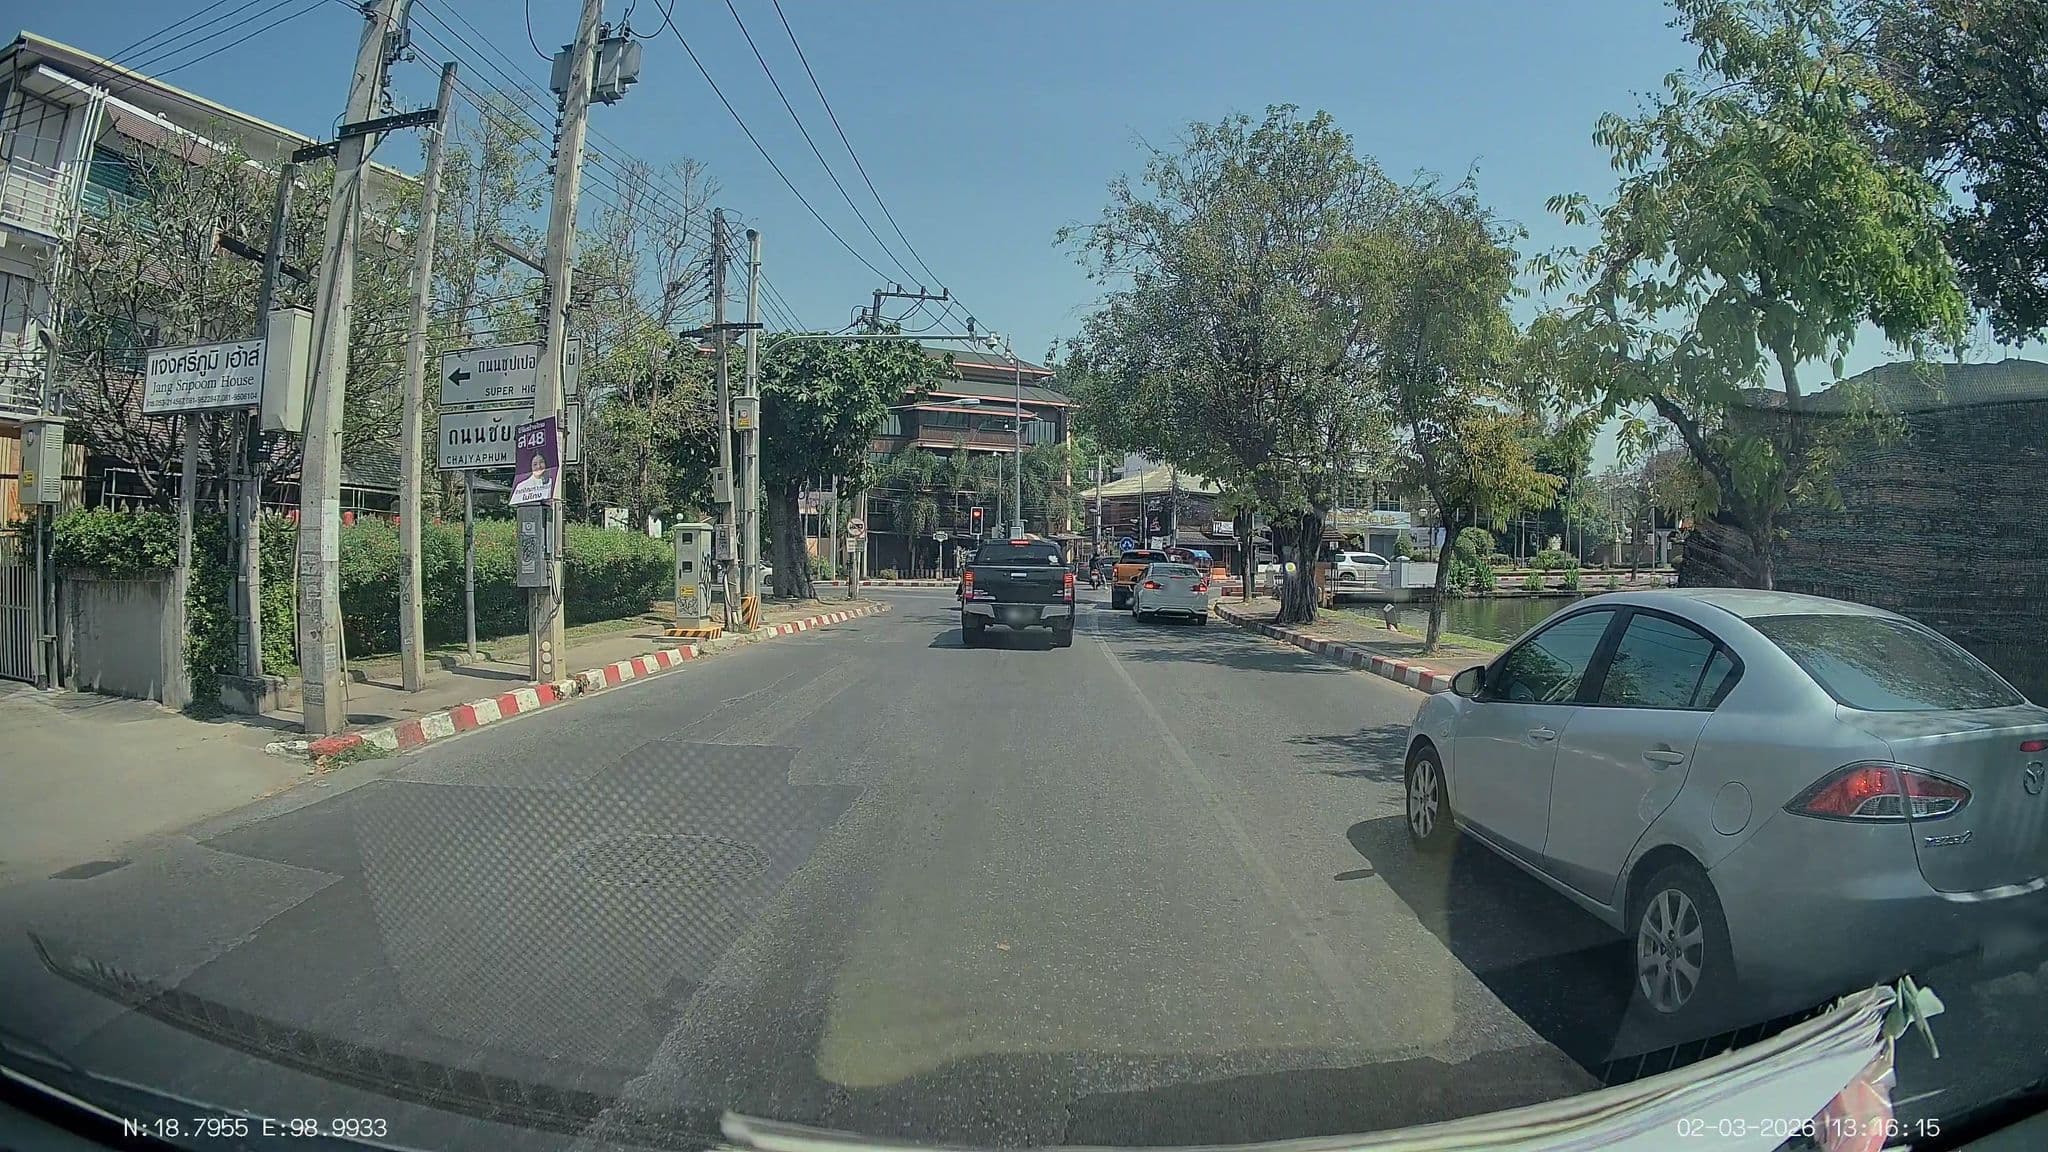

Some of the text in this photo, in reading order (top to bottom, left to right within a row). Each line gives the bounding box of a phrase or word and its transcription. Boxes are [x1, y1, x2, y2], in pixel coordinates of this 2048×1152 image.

[151, 375, 255, 396] Jang Sripoom House
[485, 386, 514, 397] SUPER
[528, 431, 544, 447] 48
[446, 452, 507, 465] CHAIYAPHUM
